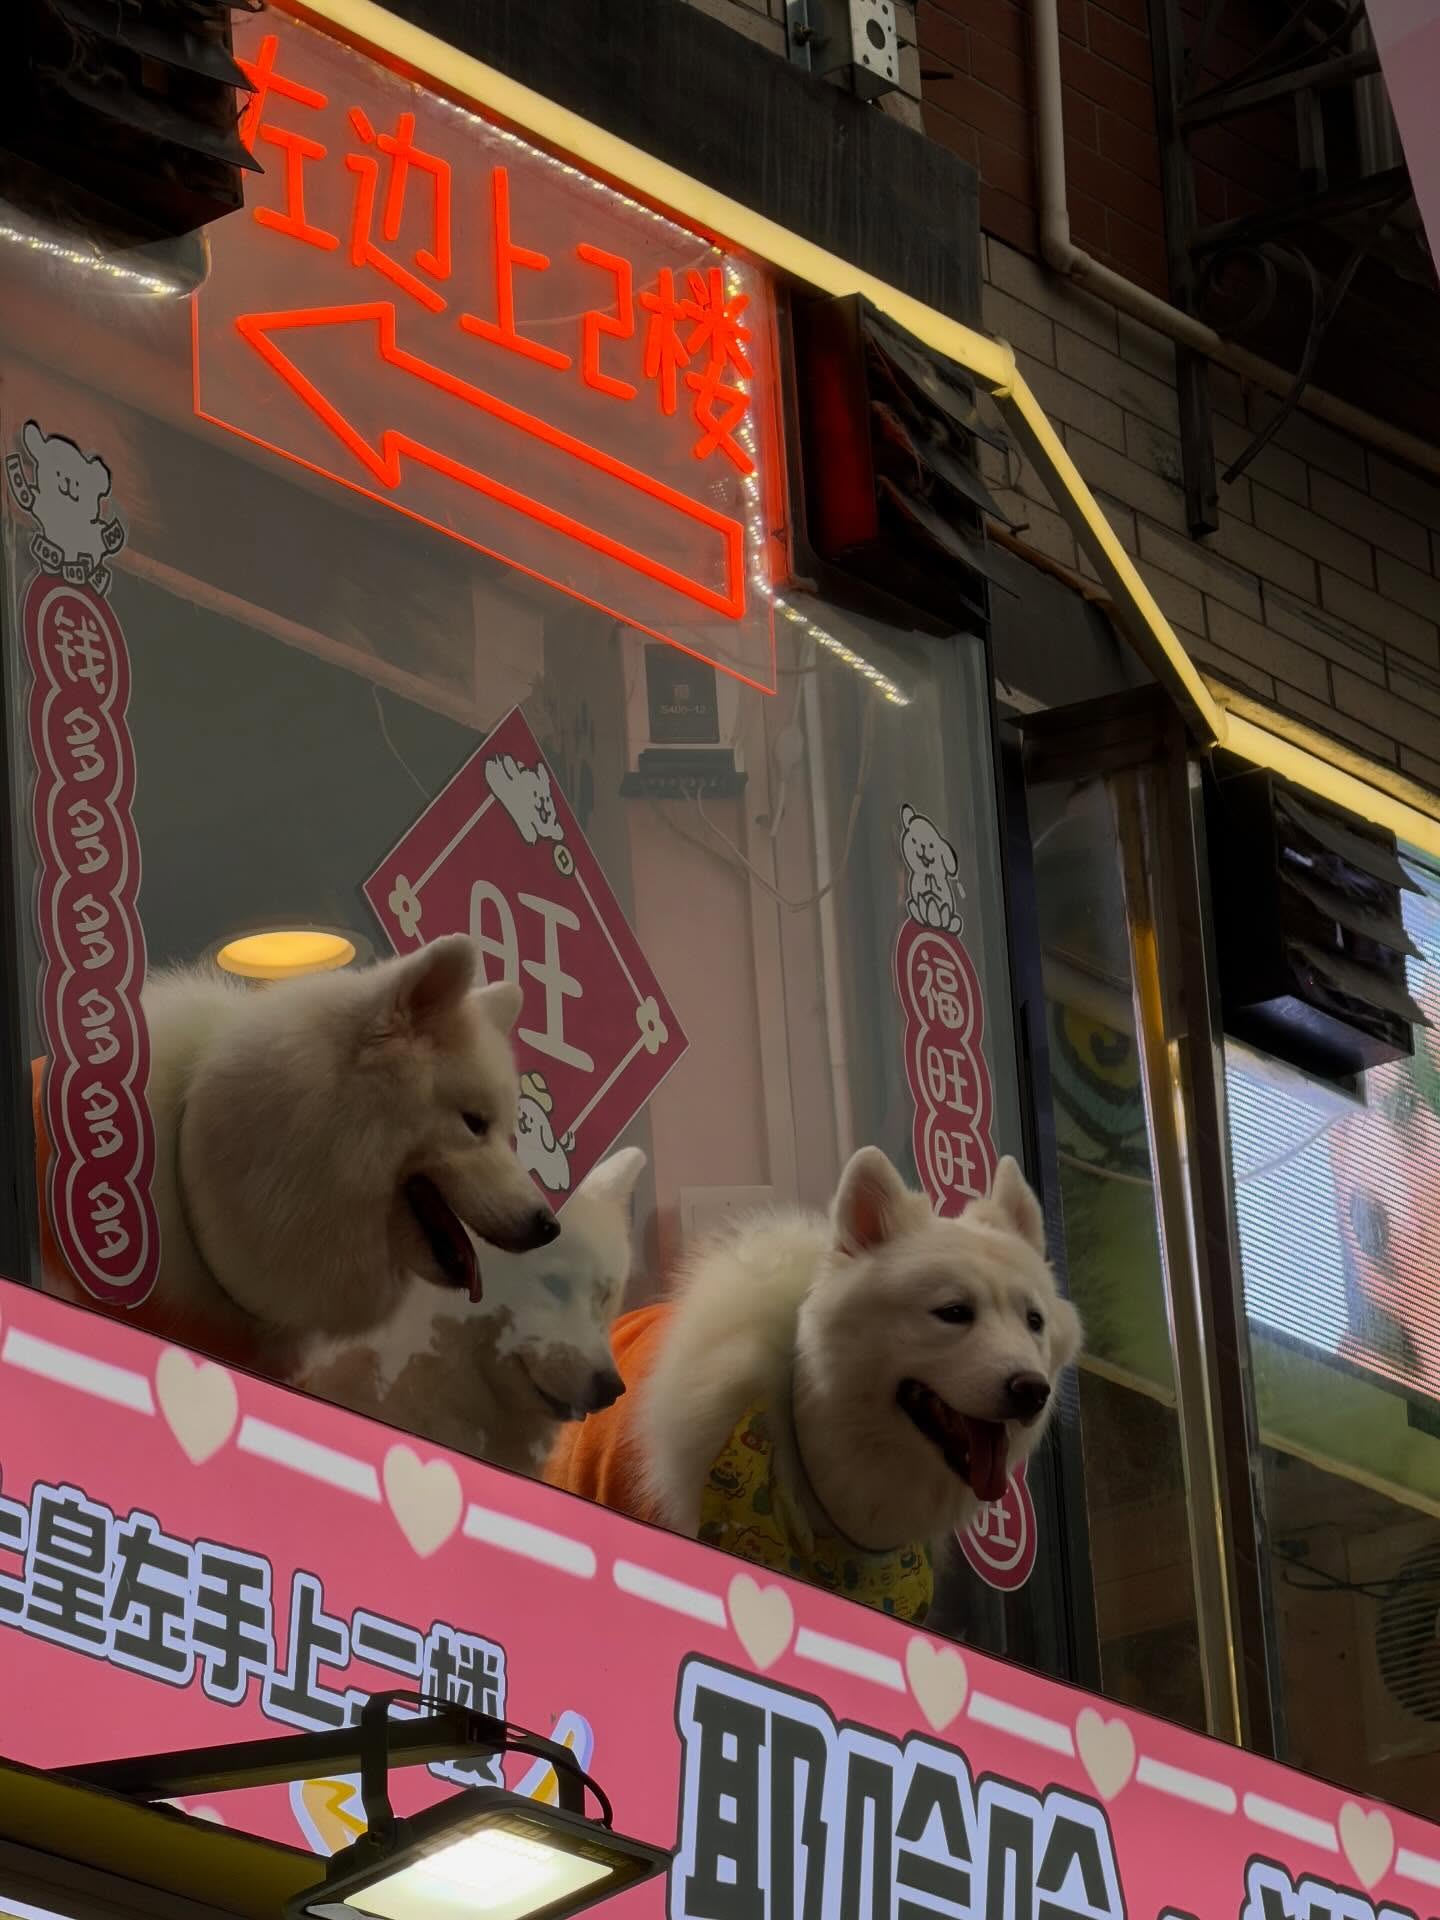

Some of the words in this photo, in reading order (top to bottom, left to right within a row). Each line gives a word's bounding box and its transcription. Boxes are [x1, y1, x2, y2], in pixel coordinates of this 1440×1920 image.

[234, 35, 754, 474] 左边上2楼
[469, 880, 595, 1072] 旺
